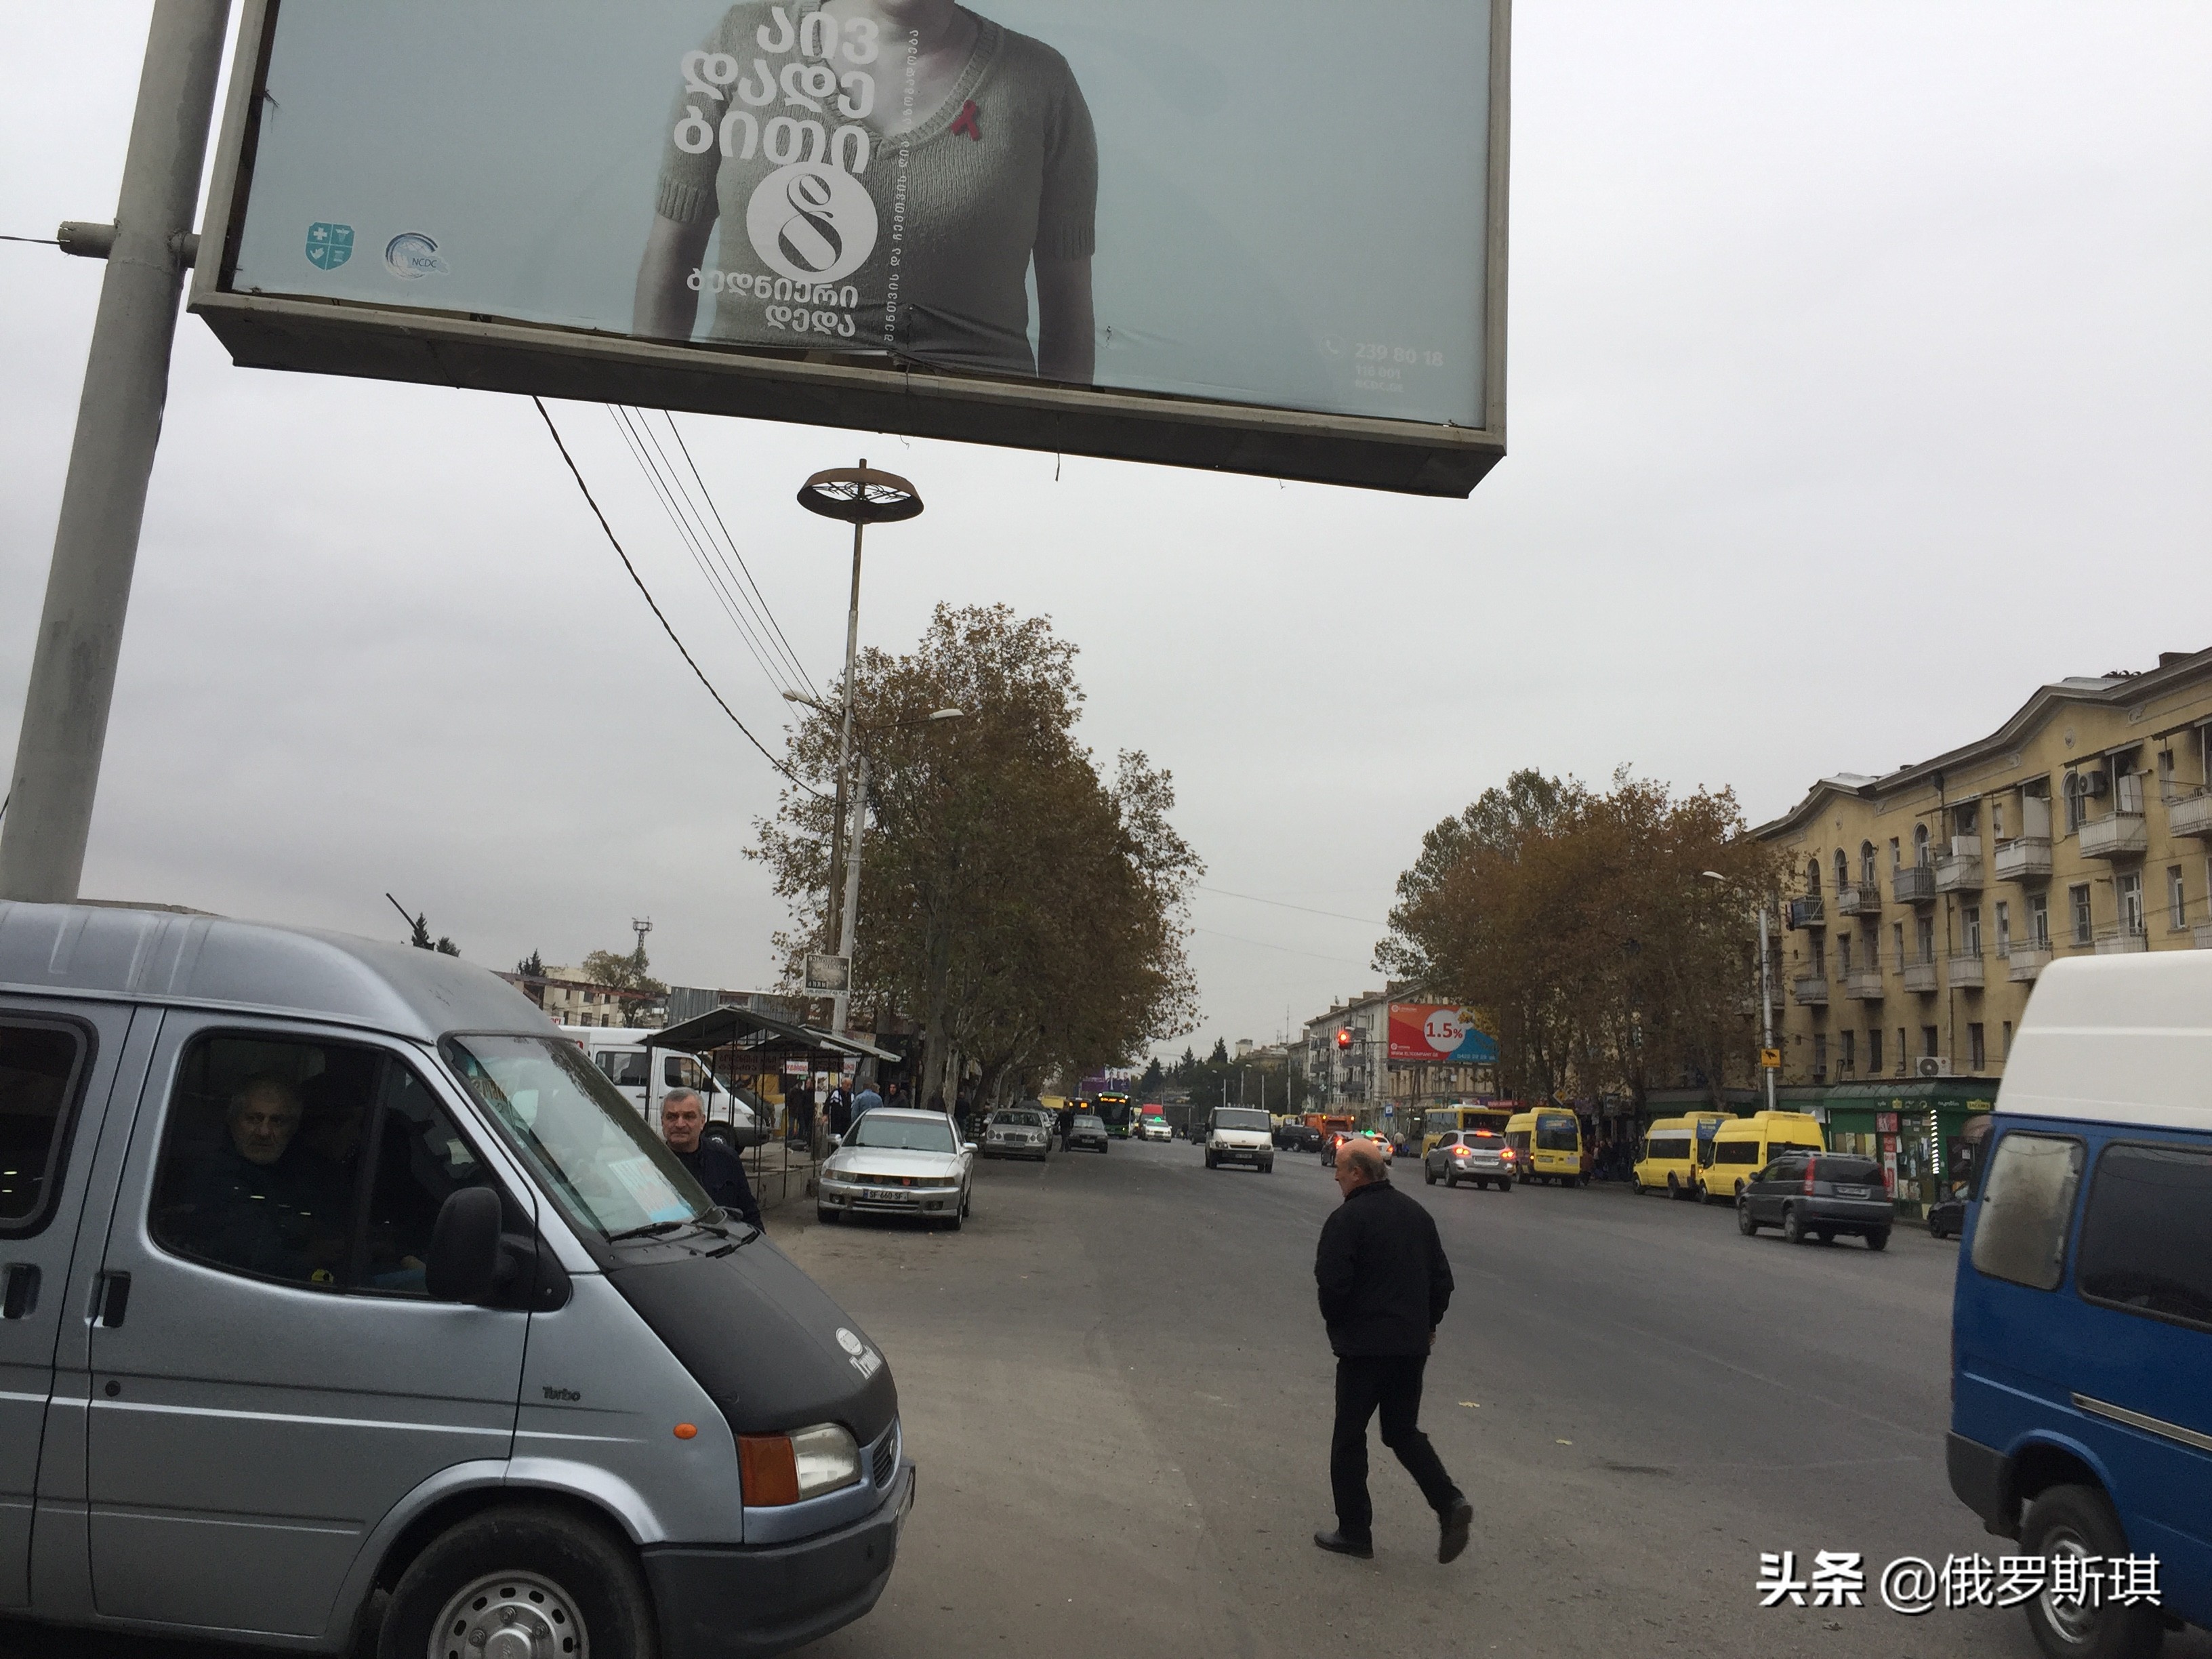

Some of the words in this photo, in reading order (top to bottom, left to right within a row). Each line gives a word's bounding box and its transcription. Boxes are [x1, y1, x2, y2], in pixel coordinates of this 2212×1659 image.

[756, 6, 879, 64] აივ
[680, 50, 876, 119] დადე
[674, 106, 869, 174] ბითი
[893, 176, 907, 241] ჩემთვის
[412, 258, 438, 268] NCDC
[889, 247, 901, 266] და
[687, 268, 858, 308] ბედნიერი
[766, 304, 856, 337] დედა
[884, 274, 900, 342] შენთვის
[1393, 347, 1417, 364] 80
[1424, 350, 1444, 367] 18
[1426, 1021, 1463, 1038] 1.5%
[543, 1386, 581, 1401] Turbo
